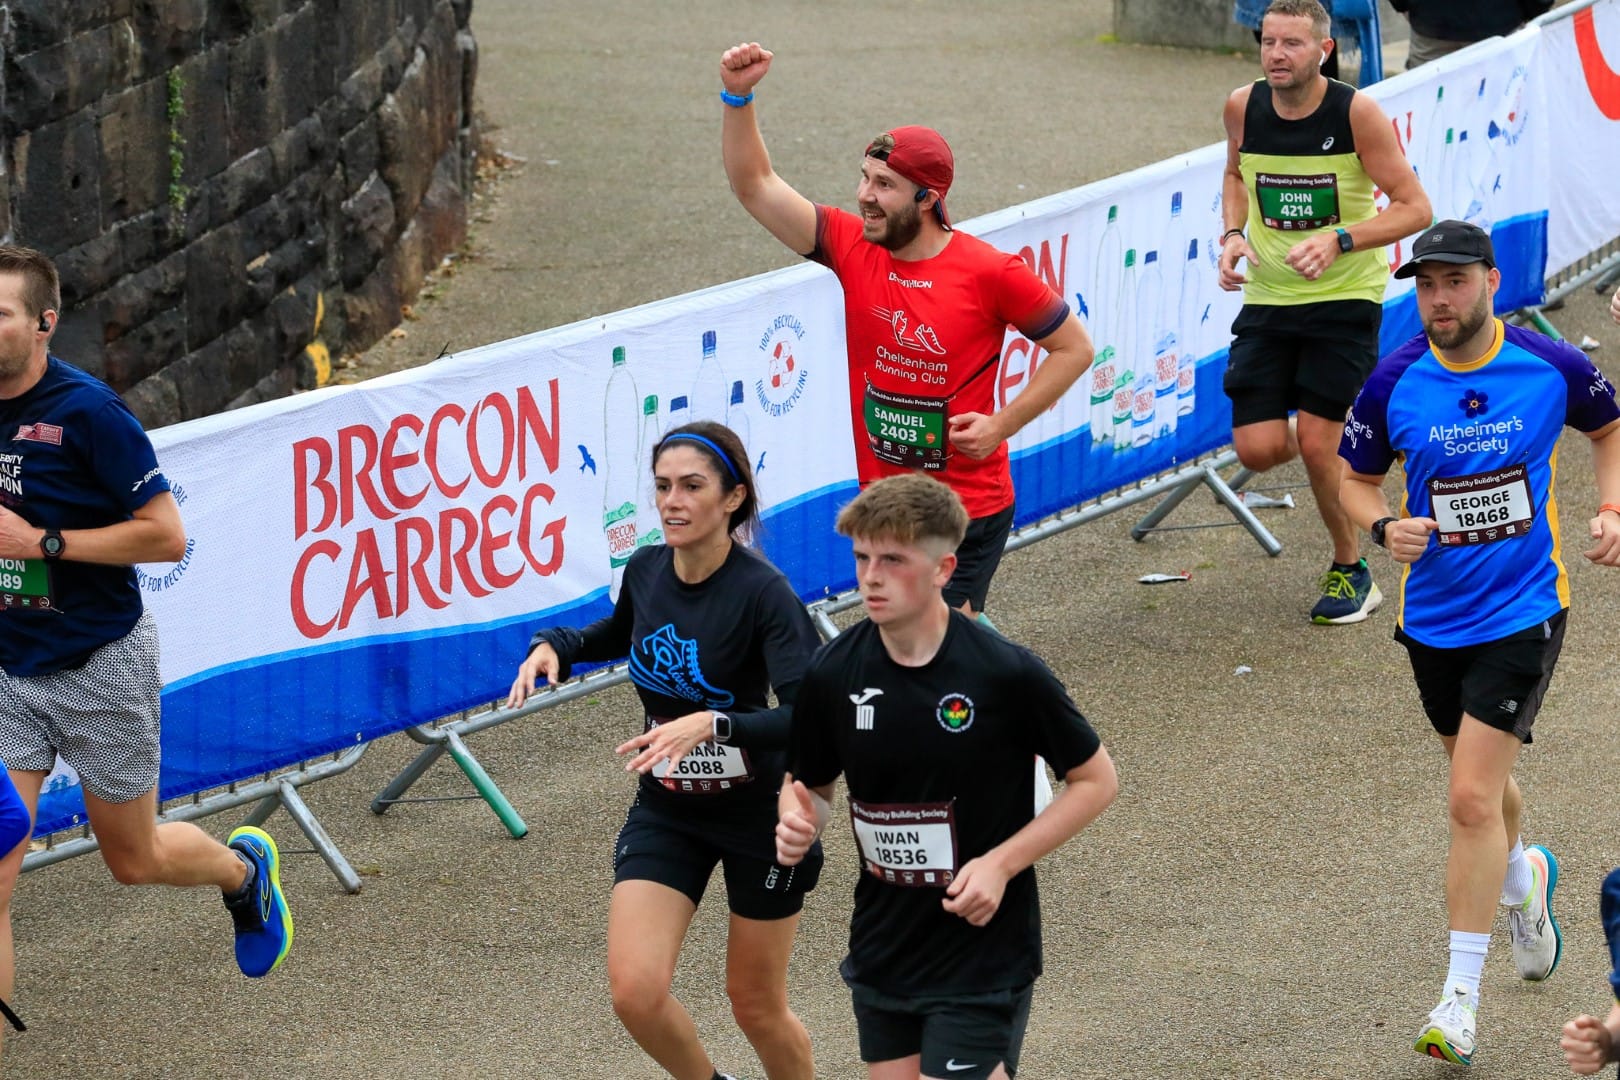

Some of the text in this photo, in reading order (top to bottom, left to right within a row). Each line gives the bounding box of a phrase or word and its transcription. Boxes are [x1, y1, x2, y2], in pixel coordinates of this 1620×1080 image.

[1279, 192, 1313, 203] JOHN
[1280, 204, 1314, 217] 4214
[876, 345, 948, 373] Cheltenham
[875, 359, 947, 385] Running Club
[874, 407, 926, 428] SAMUEL
[880, 422, 918, 443] 2403
[1428, 415, 1524, 443] Alzheimer's
[1444, 436, 1509, 456] Society
[293, 378, 560, 541] BRECON
[1439, 469, 1523, 490] Principality Building Society
[1449, 490, 1511, 511] GEORGE
[1455, 506, 1510, 528] 18468
[147, 576, 162, 592] FOR
[164, 538, 196, 590] RECYCLING
[290, 483, 567, 639] CARREG
[0, 572, 23, 590] 89
[672, 760, 724, 775] 6088
[890, 810, 921, 820] Building
[920, 809, 948, 819] Society
[874, 831, 920, 845] IWAN
[875, 847, 928, 865] 18536
